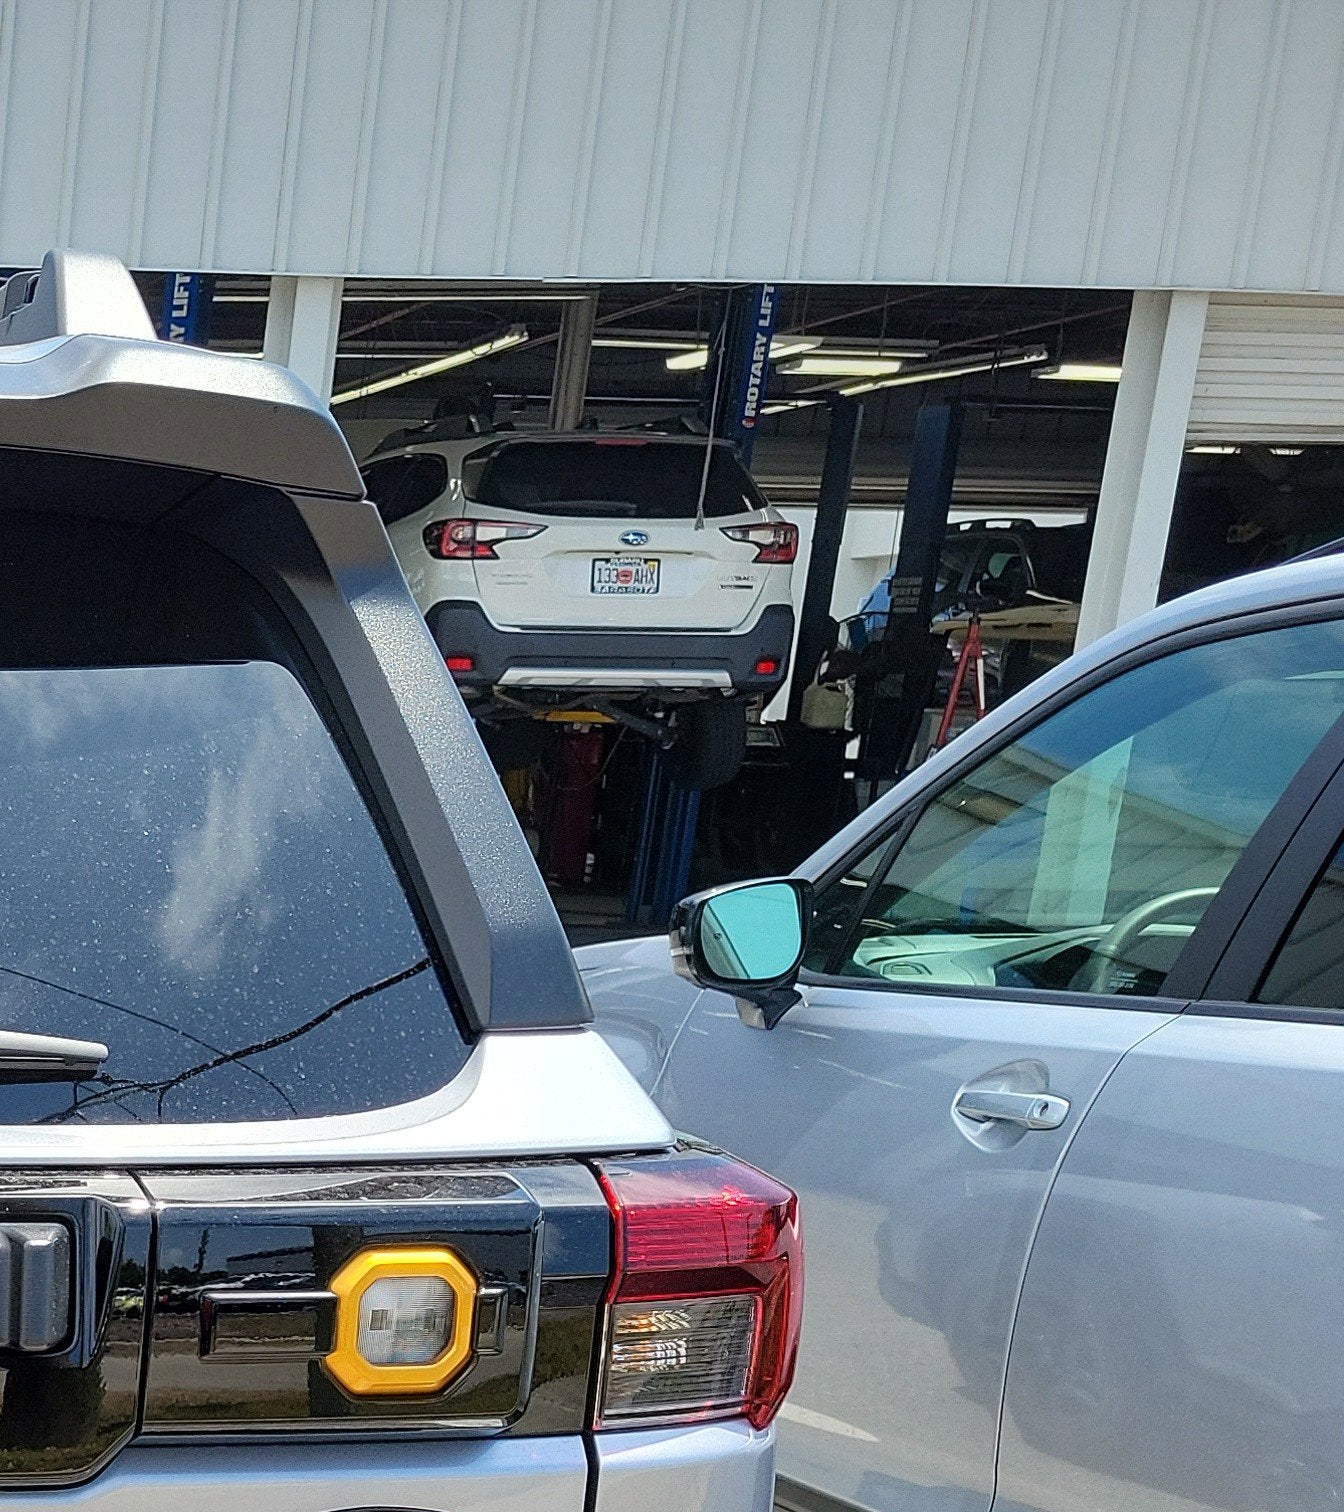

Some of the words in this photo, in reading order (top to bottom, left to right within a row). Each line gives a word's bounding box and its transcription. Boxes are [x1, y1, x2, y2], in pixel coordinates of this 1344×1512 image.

[172, 273, 191, 318] LIFT
[744, 331, 767, 417] ROTARY
[758, 283, 774, 327] LIFT
[596, 568, 619, 583] 133
[633, 568, 656, 584] AHX
